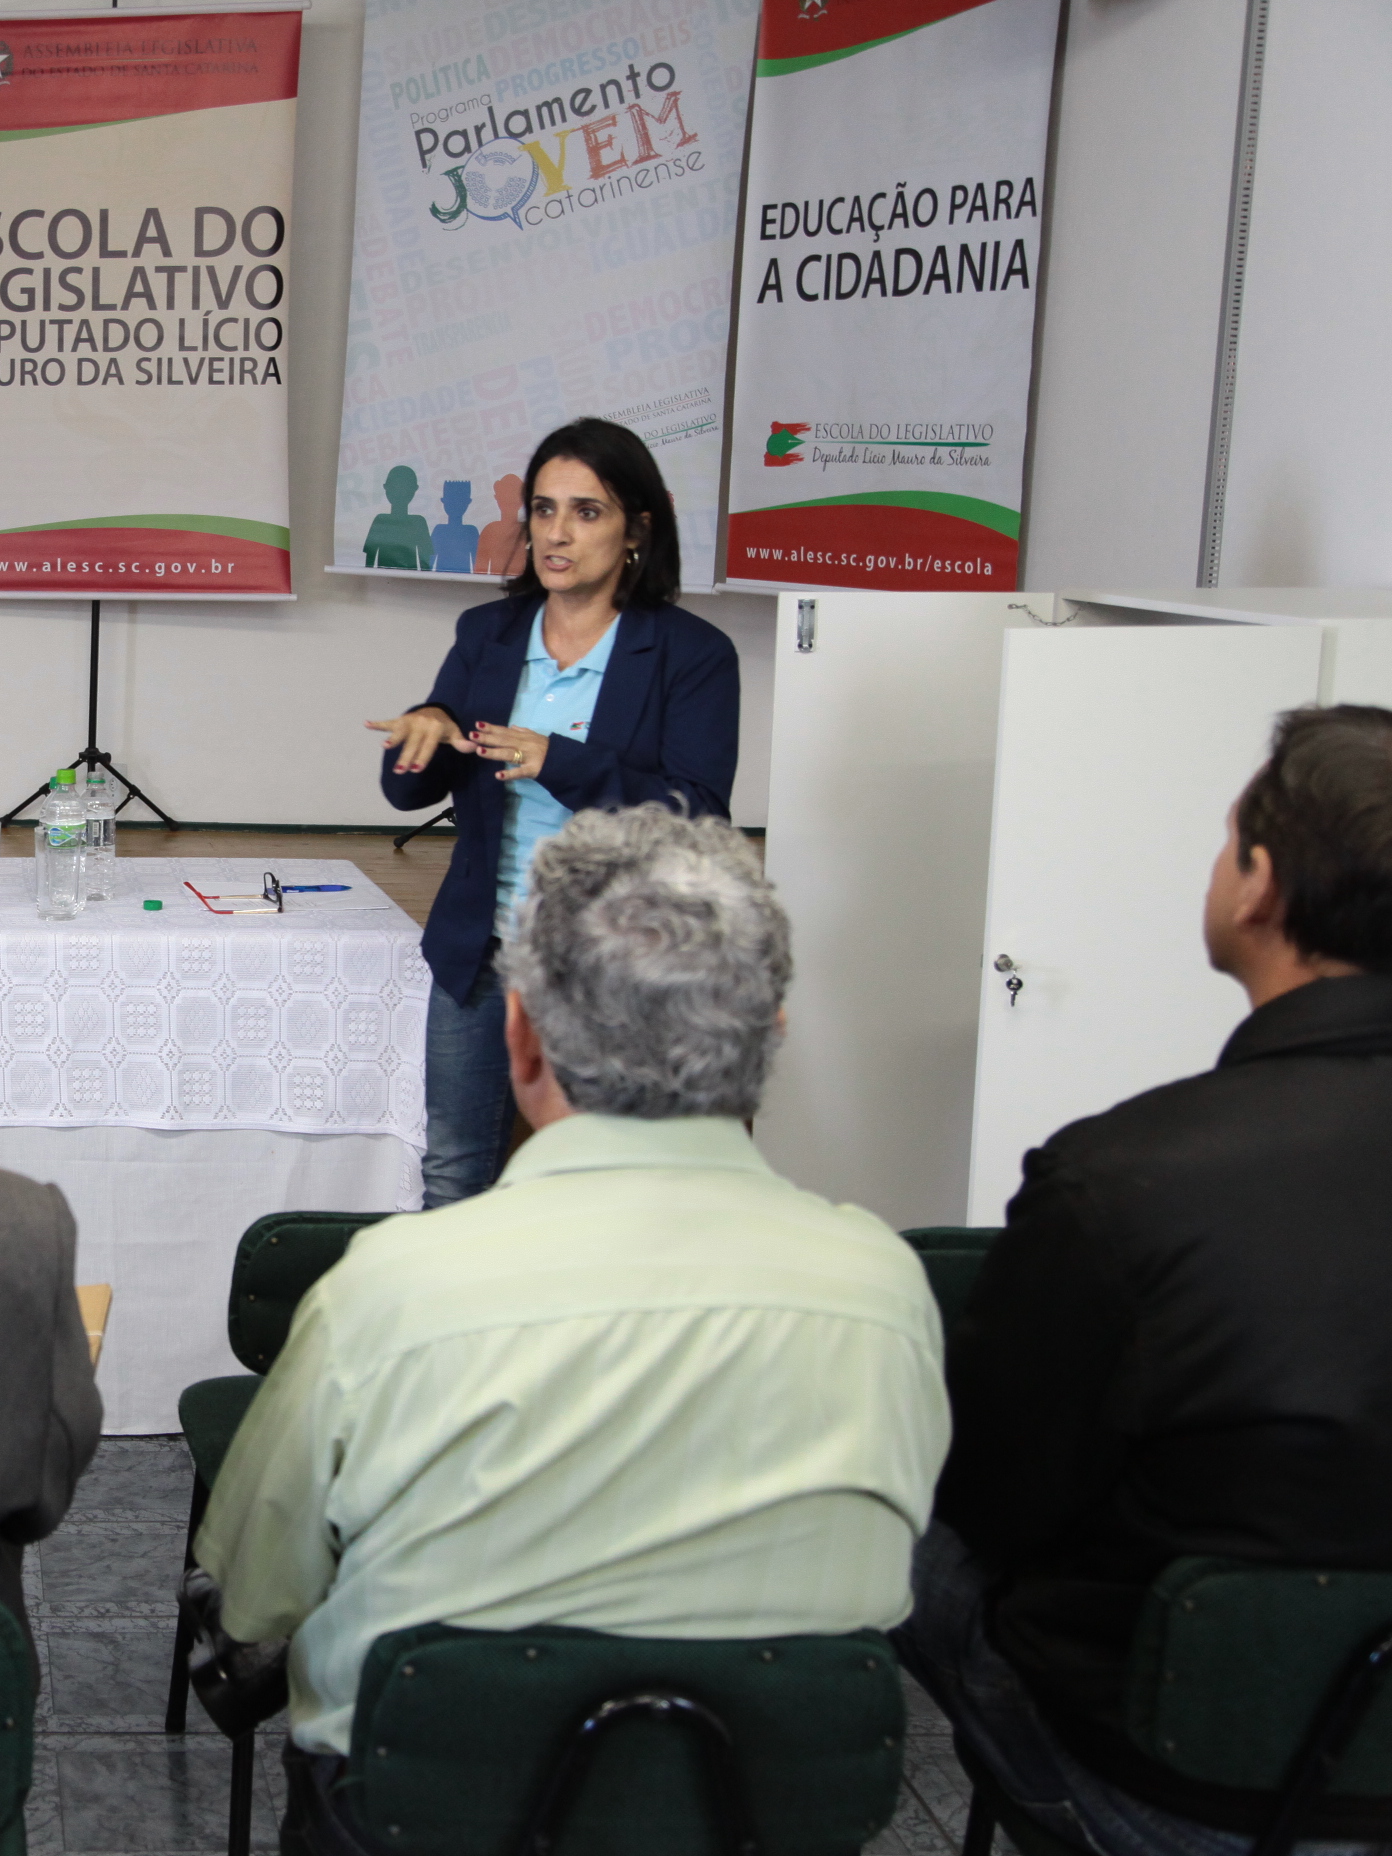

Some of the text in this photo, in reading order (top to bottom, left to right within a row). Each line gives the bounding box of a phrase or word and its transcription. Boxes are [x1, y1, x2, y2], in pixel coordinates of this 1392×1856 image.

[22, 38, 258, 59] ASSEMBLEIA LEGISLATIVA
[640, 19, 691, 57] LEIS
[134, 64, 180, 76] SANTA
[184, 62, 258, 75] CATARINA
[389, 54, 491, 110] POLÍTICA
[494, 37, 640, 103] PROGRESSO
[410, 93, 492, 129] Programa
[414, 61, 677, 170] Parlamento
[429, 90, 698, 230] JOVEM
[524, 150, 705, 226] catarinense
[760, 177, 1037, 243] EDUCAÇÃO PARA
[194, 205, 285, 258] DO
[757, 238, 1030, 304] A CIDADANIA
[178, 310, 283, 352] LÍCIO
[76, 357, 125, 386] DA
[134, 356, 282, 386] SILVEIRA
[598, 386, 710, 422] ASSEMBLEIA LEGISLATIVA
[653, 408, 676, 419] SANTA
[677, 397, 712, 412] CATARINA
[644, 413, 717, 440] DO LEGISLATIVO
[814, 423, 994, 441] ESCOLA DO LEGISLATIVO
[812, 446, 991, 472] Deputado Lício Mauro da Silveira
[746, 545, 992, 576] www.alesc.sc.gov.br/escola
